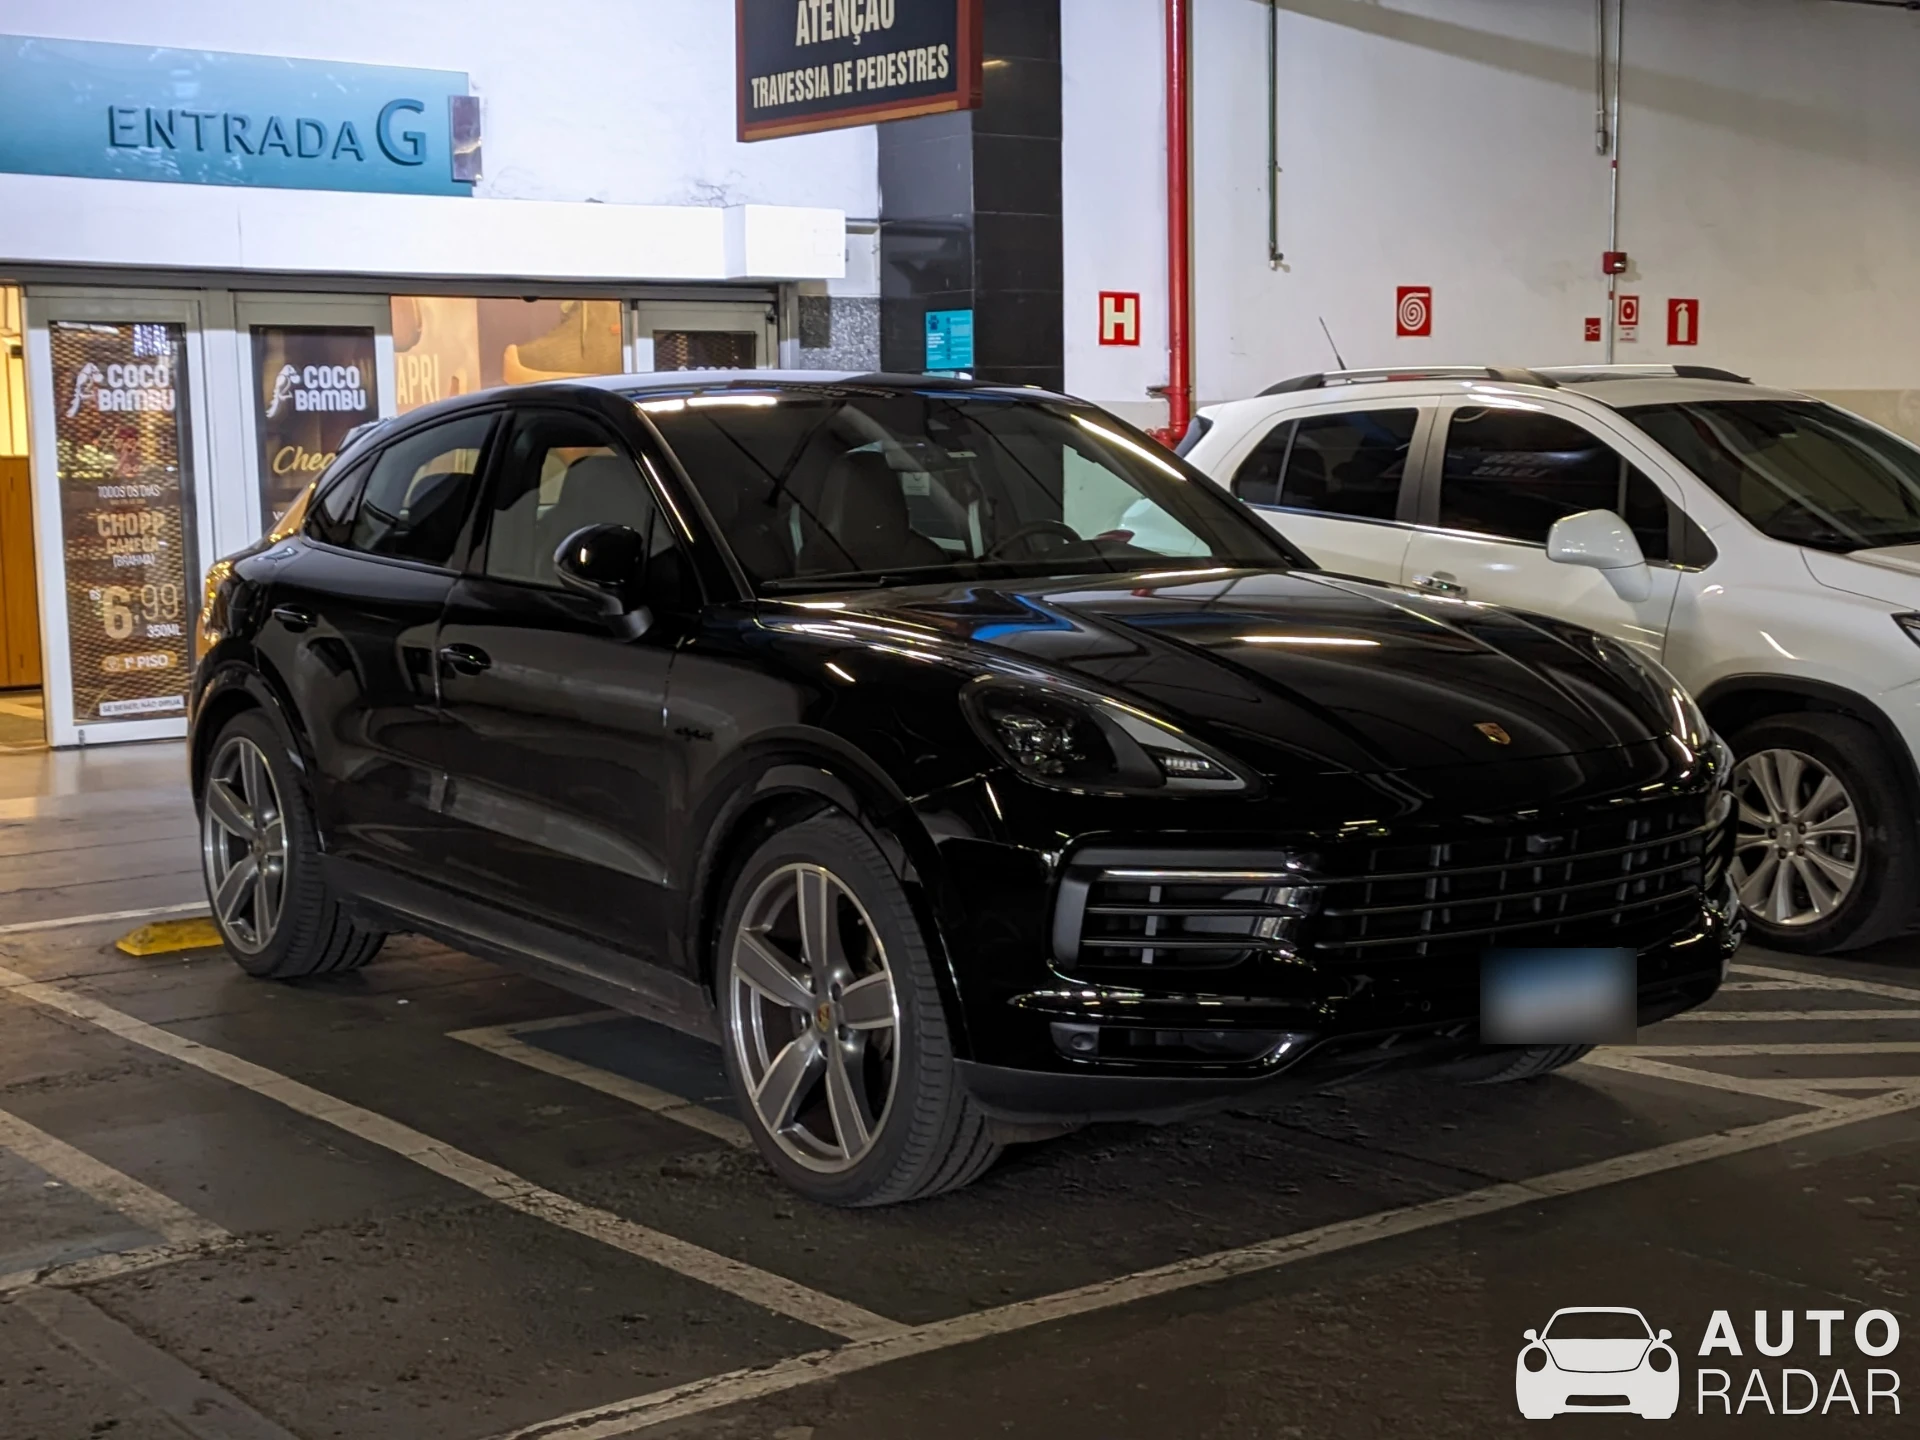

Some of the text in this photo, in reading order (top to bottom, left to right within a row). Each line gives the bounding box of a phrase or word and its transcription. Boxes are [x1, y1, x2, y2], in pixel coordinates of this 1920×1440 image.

[751, 43, 949, 108] TRAVESSIA DE PEDESTRES
[107, 97, 428, 167] ENTRADA G
[1103, 296, 1136, 340] H
[107, 363, 170, 388] COCO
[303, 365, 360, 389] COCO
[97, 389, 176, 411] BAMBU
[294, 389, 367, 411] BAMBU
[97, 484, 161, 498] TODOS OS DIAS
[97, 510, 166, 537] CHOPP
[136, 653, 169, 668] PISO
